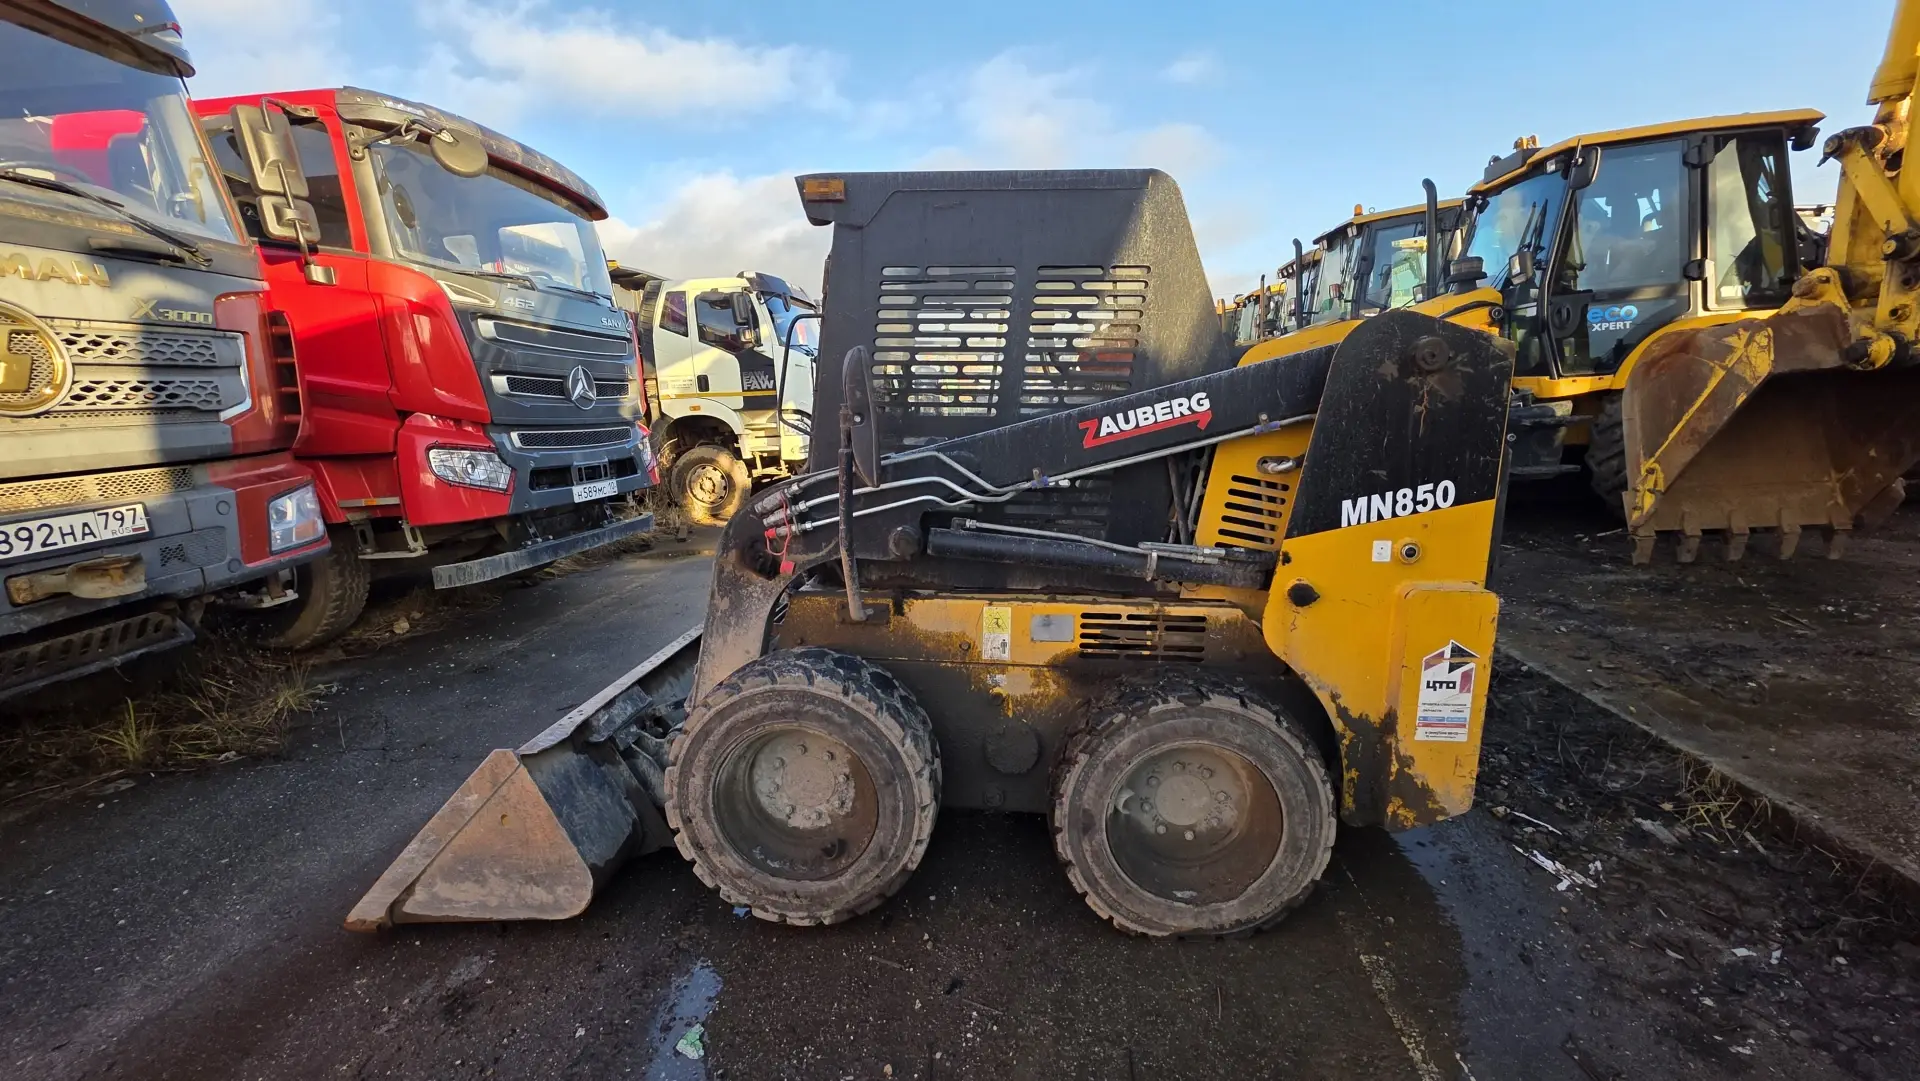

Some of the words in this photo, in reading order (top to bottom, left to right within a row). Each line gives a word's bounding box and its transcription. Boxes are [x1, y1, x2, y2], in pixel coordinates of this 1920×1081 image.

[600, 317, 621, 328] SANY
[1591, 320, 1633, 332] XPERT
[743, 379, 774, 390] FAW
[1078, 391, 1213, 449] ZAUBERG
[1340, 479, 1456, 528] MN850
[97, 507, 138, 530] 797
[111, 526, 131, 536] RUS
